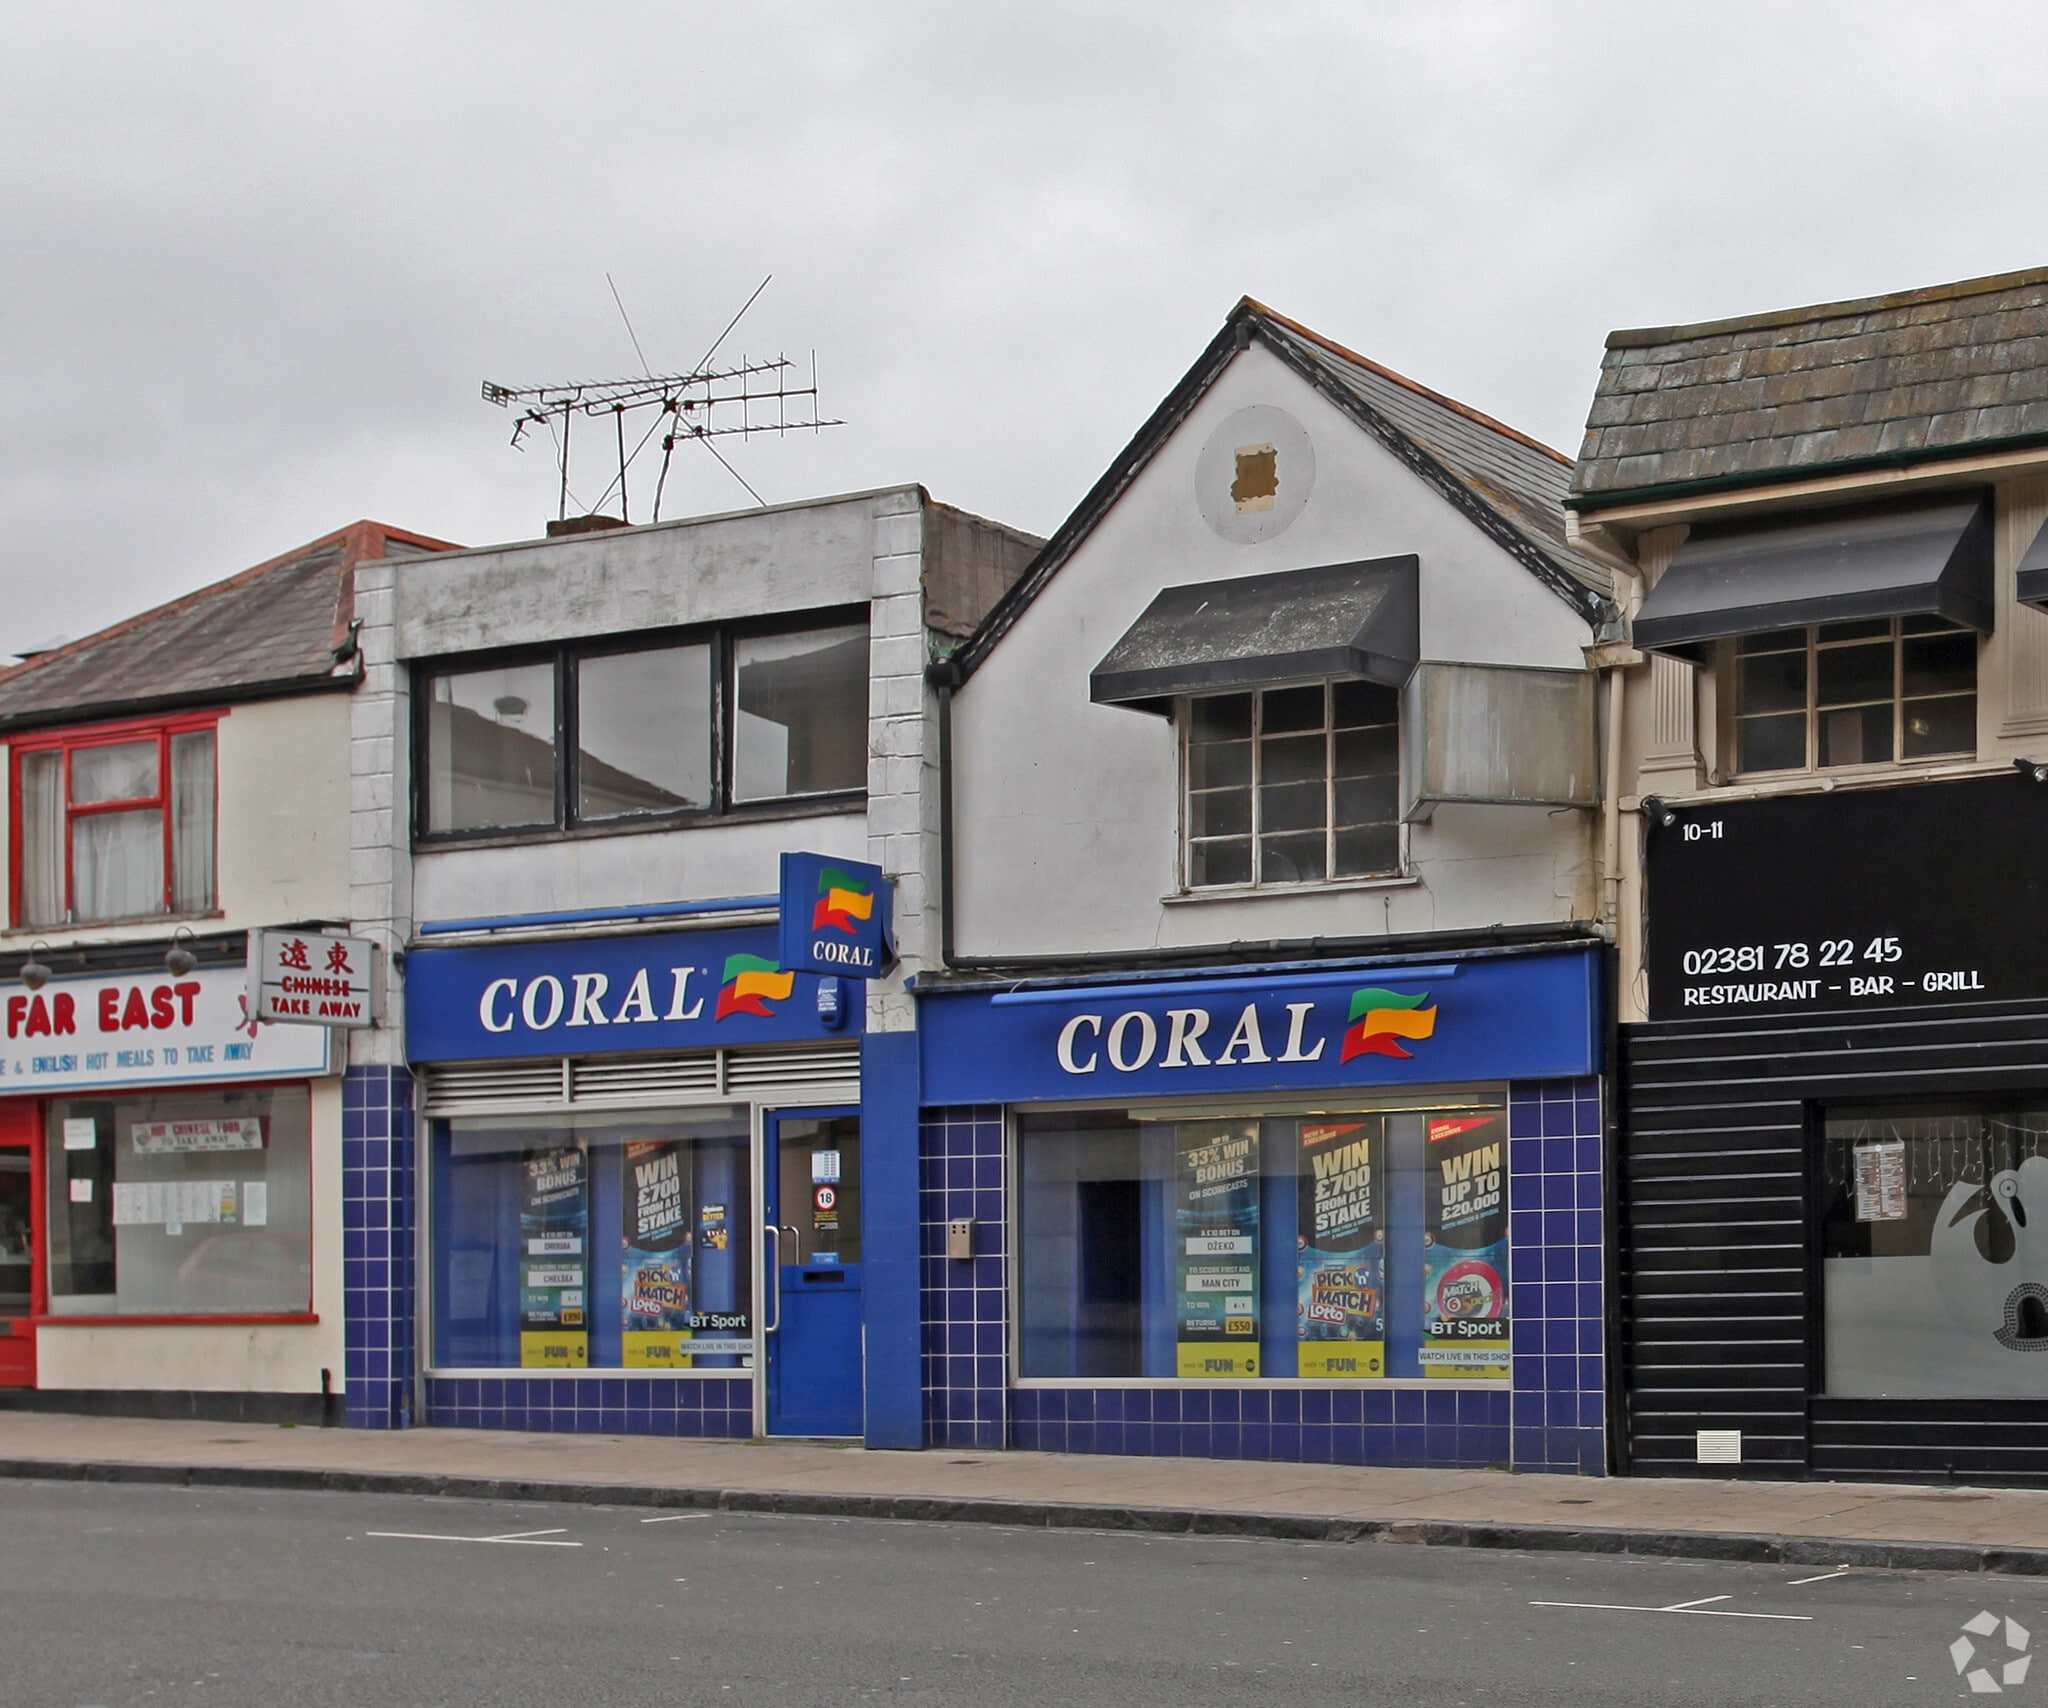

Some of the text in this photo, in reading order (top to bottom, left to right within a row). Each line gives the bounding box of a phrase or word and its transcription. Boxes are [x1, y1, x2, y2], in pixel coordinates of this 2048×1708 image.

[1682, 821, 1723, 841] 10-11
[812, 940, 873, 967] CORAL
[1683, 937, 1902, 975] 02381 78 22 45
[281, 975, 350, 997] CHINESE
[1683, 980, 1821, 1006] RESTAURANT
[1849, 976, 1894, 997] BAR
[1922, 970, 1984, 992] GRILL
[7, 993, 76, 1039] FAR
[98, 981, 201, 1033] EAST
[271, 996, 361, 1018] TAKE AWAY
[479, 966, 704, 1033] CORAL
[1057, 1002, 1326, 1074] CORAL
[32, 1054, 77, 1074] ENGLISH
[86, 1052, 108, 1070] HOT
[116, 1049, 154, 1068] MEALS
[164, 1047, 178, 1066] TO
[187, 1045, 214, 1064] TAKE
[223, 1042, 254, 1062] AWAY
[173, 1122, 210, 1136] CHINESE
[560, 1152, 580, 1169] WIN
[1188, 1139, 1249, 1167] 33% WIN
[1312, 1138, 1369, 1180] WIN
[1441, 1142, 1500, 1185] WIN
[537, 1169, 576, 1191] BONUS
[635, 1152, 678, 1188] WIN
[1196, 1159, 1244, 1183] BONUS
[638, 1175, 680, 1207] £700
[1189, 1179, 1248, 1200] ON SCORECASTS
[1315, 1165, 1370, 1201] £700
[1442, 1170, 1500, 1206] UP TO
[638, 1201, 664, 1218] FROM
[665, 1198, 672, 1208] A
[819, 1191, 833, 1204] 18
[1315, 1186, 1370, 1214] FROM A £1
[1442, 1191, 1500, 1221] £20,000
[638, 1205, 682, 1233] STAKE
[1315, 1199, 1370, 1231] STAKE
[543, 1275, 574, 1283] CHELSEA
[638, 1270, 667, 1283] PICK
[1201, 1278, 1241, 1287] MAN CITY
[1316, 1272, 1353, 1287] PICK
[640, 1286, 683, 1305] MATCH
[1444, 1281, 1479, 1298] MATCH
[1317, 1290, 1371, 1312] MATCH
[1449, 1299, 1458, 1311] 6
[690, 1314, 747, 1329] BT Sport
[1228, 1321, 1251, 1332] £550
[1431, 1321, 1502, 1337] BT Sport
[1205, 1359, 1233, 1372] FUN
[1326, 1358, 1356, 1371] FUN
[1420, 1352, 1445, 1360] WATCH
[1447, 1352, 1462, 1360] LIVE
[1463, 1352, 1471, 1360] IN
[1472, 1352, 1489, 1360] THIS
